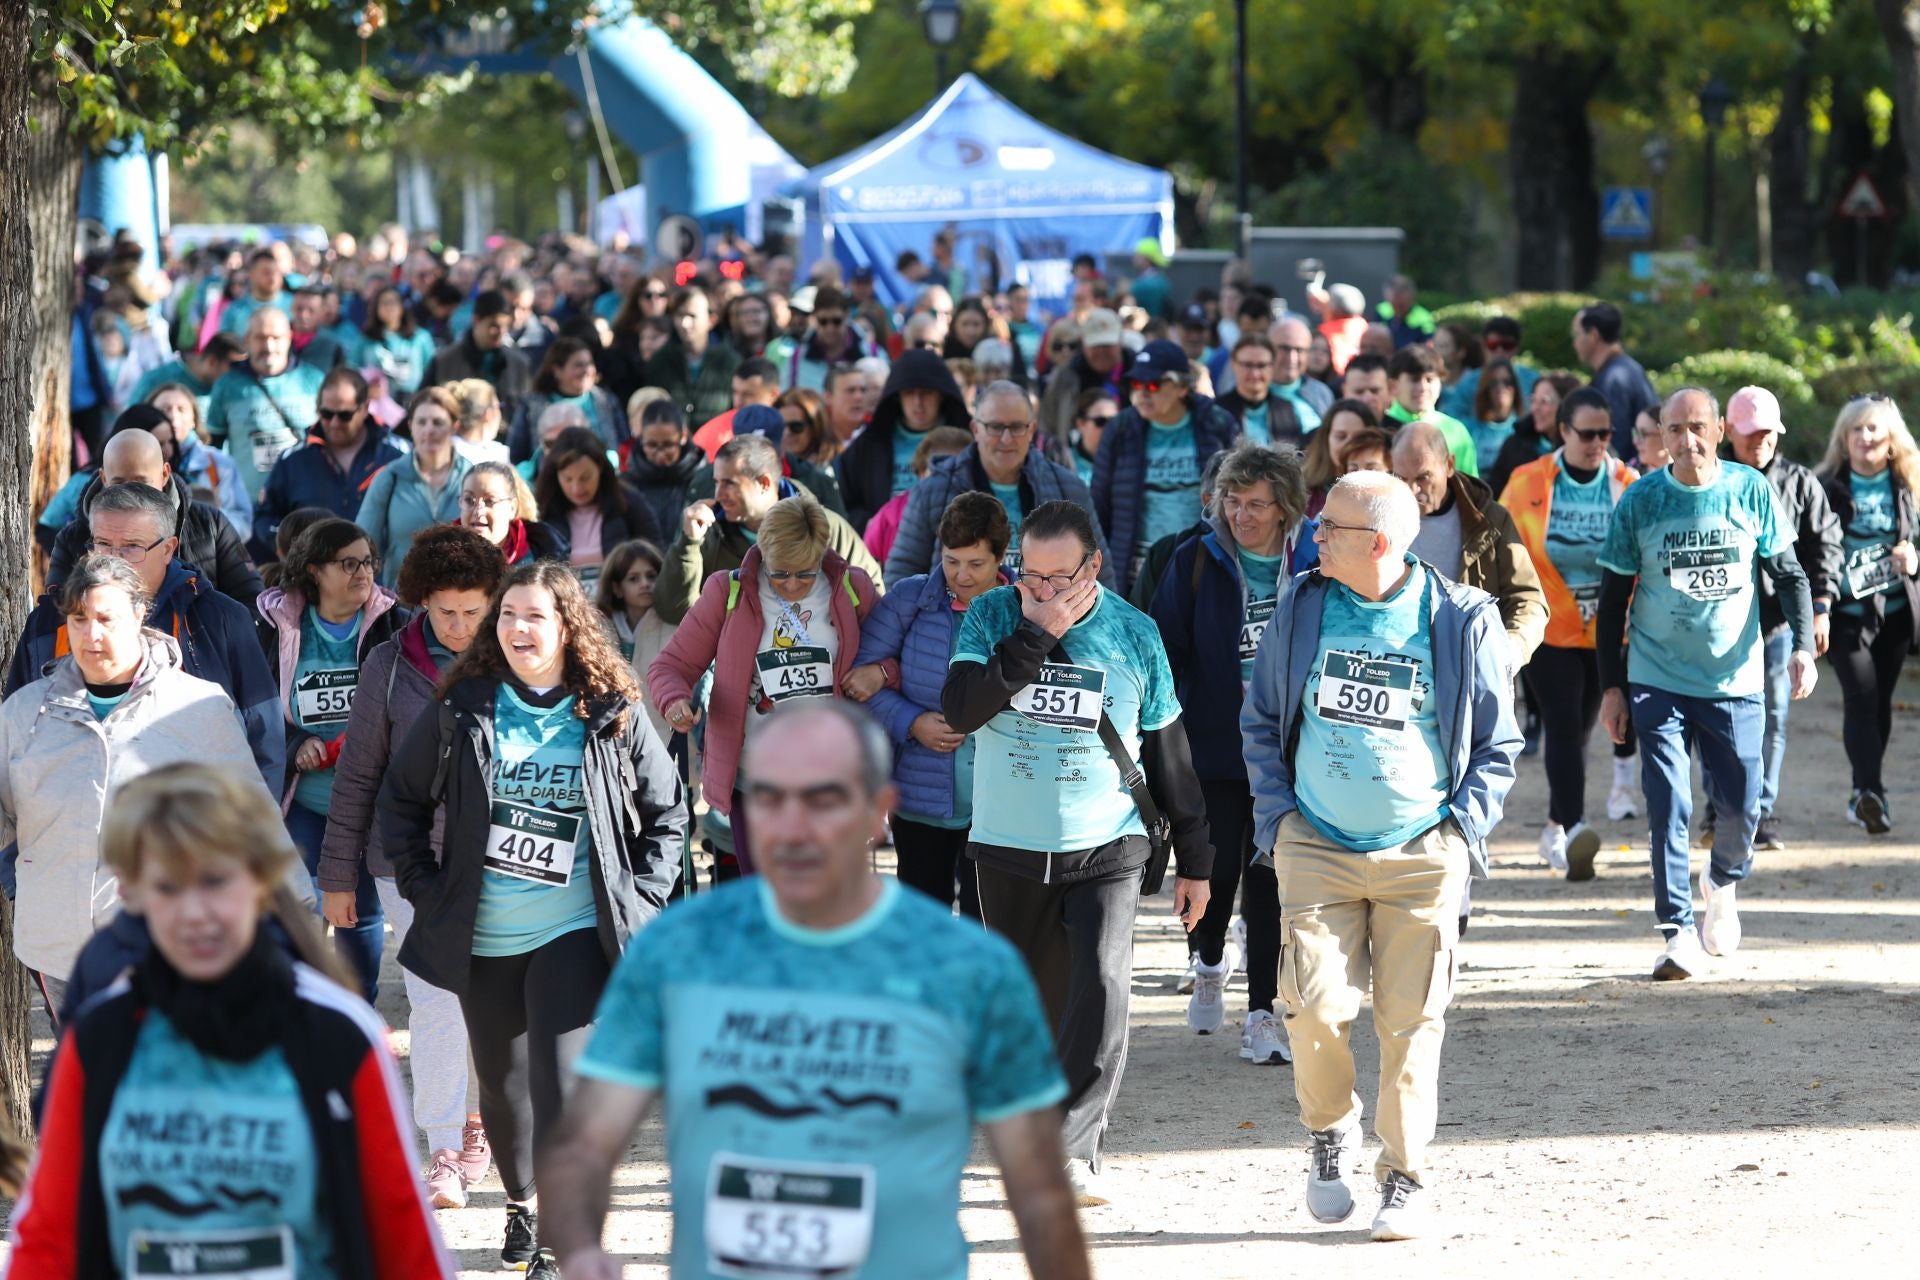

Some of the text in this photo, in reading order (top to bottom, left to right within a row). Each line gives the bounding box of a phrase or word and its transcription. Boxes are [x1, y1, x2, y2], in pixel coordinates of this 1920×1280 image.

[1687, 568, 1728, 589] 263
[1253, 606, 1275, 615] TOLEDO
[780, 667, 818, 689] 435
[1057, 671, 1082, 680] TOLEDO
[1366, 668, 1390, 677] TOLEDO
[1031, 688, 1081, 714] 551
[1337, 683, 1390, 715] 590
[505, 784, 524, 796] LA
[529, 817, 558, 828] TOLEDO
[498, 834, 555, 868] 404
[740, 1211, 831, 1260] 553
